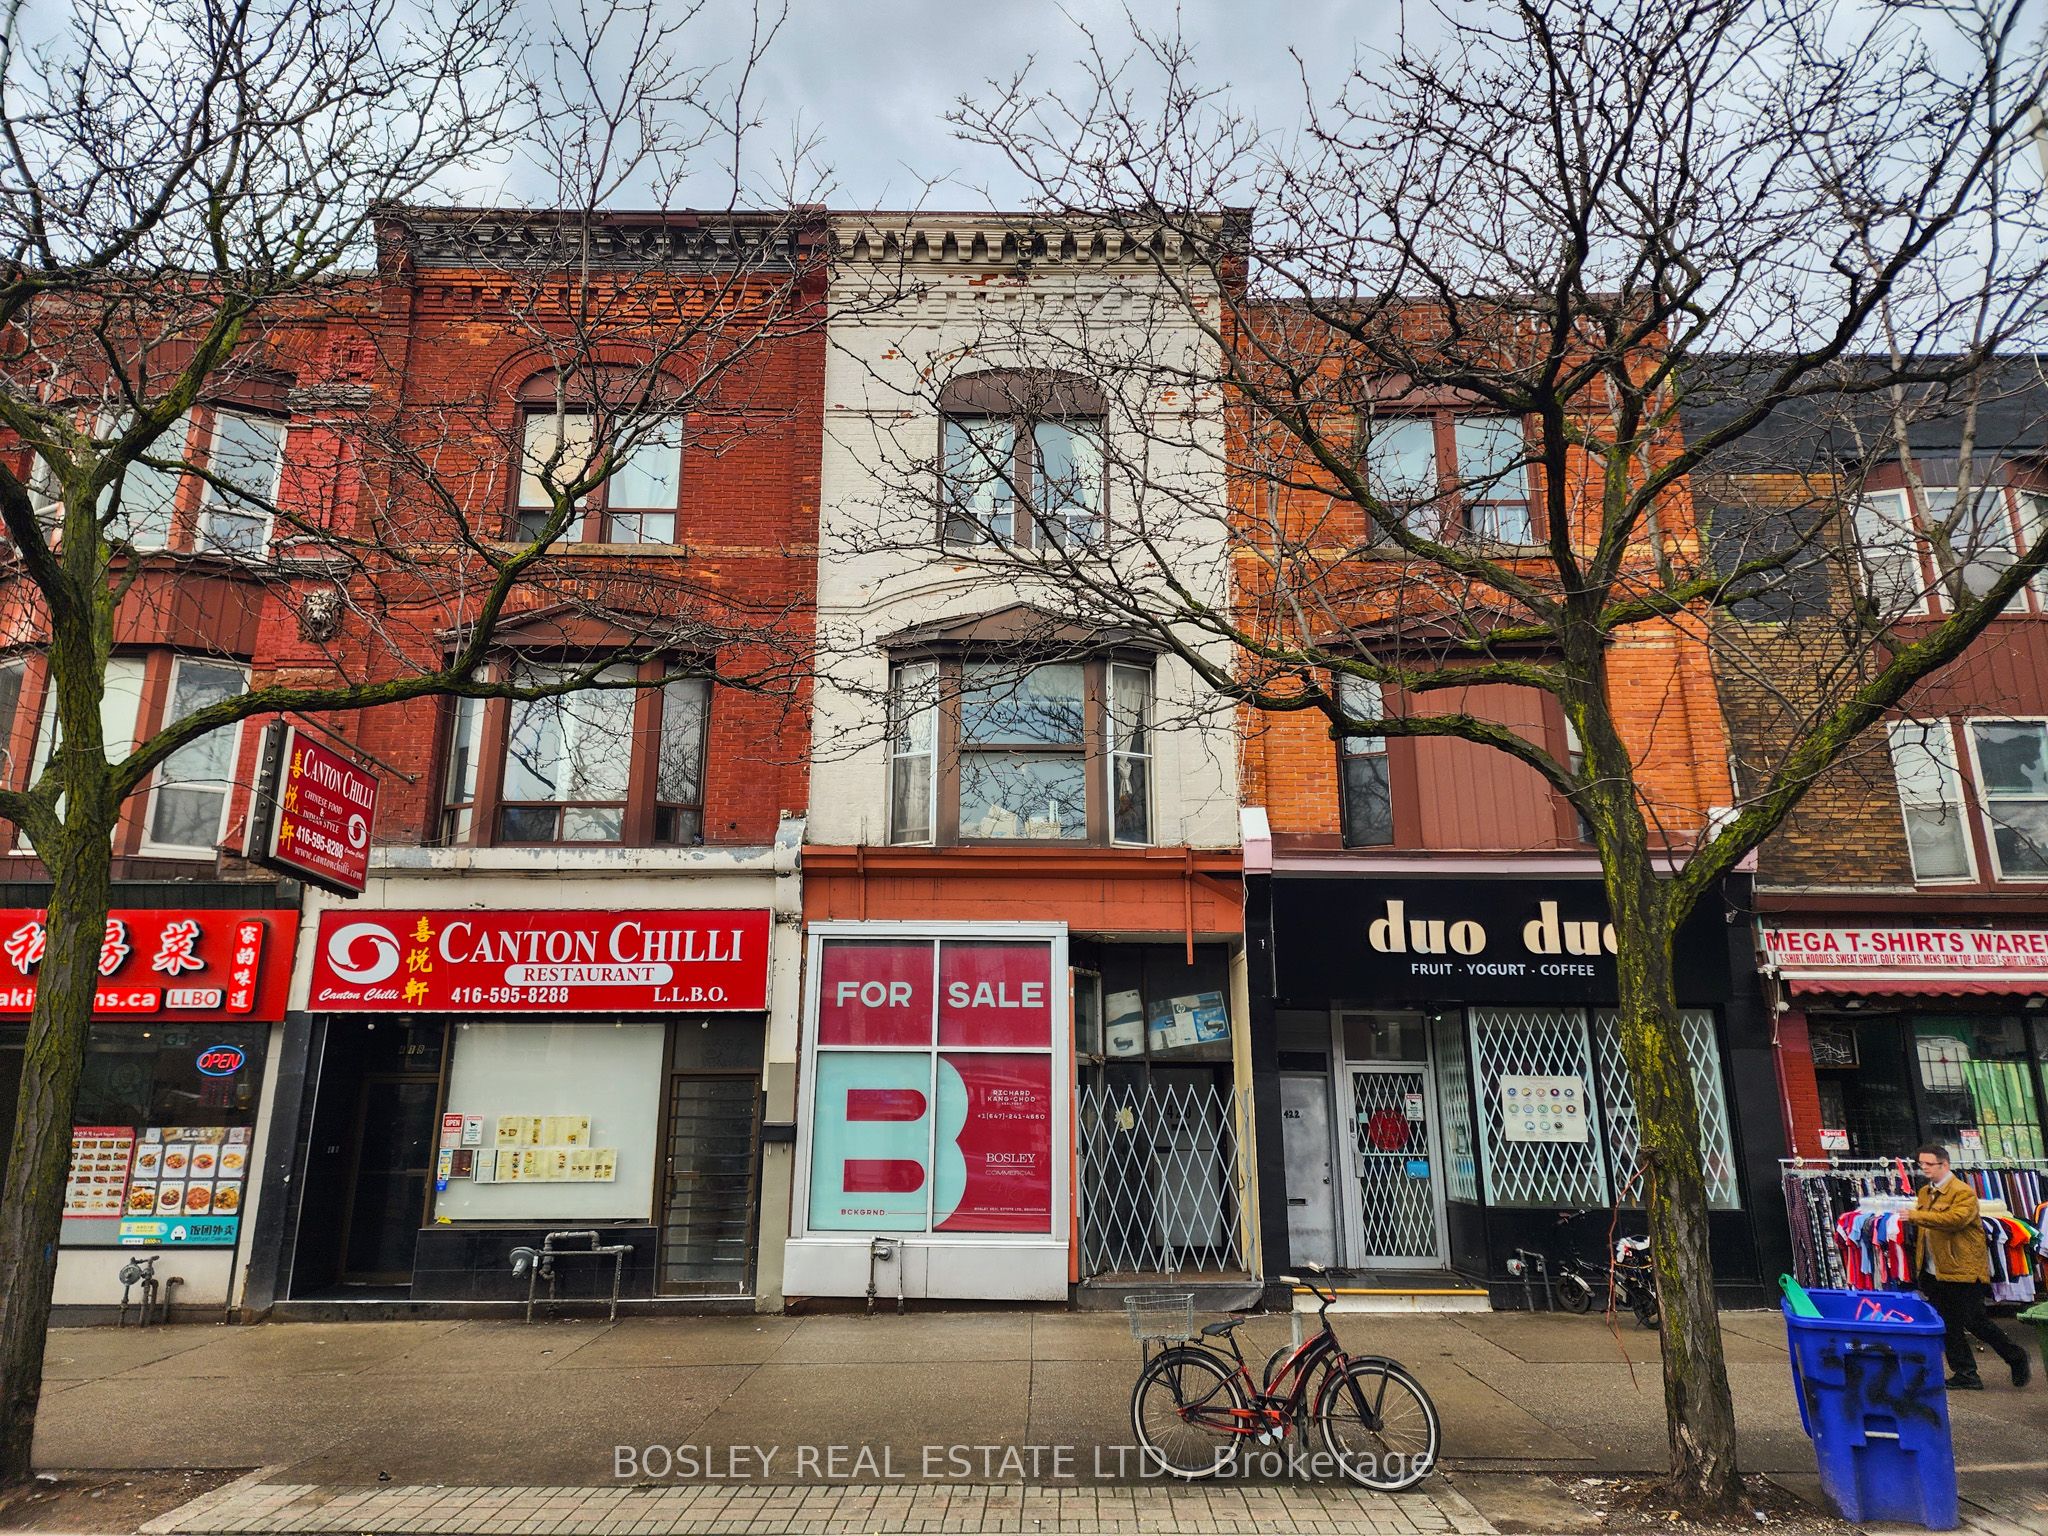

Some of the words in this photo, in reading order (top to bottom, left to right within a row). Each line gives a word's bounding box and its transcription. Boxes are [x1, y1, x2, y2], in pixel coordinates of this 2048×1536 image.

[303, 749, 344, 793] CANTON
[342, 771, 374, 810] CHILLI
[304, 790, 328, 808] CHINESE
[327, 800, 343, 815] FOOD
[322, 820, 340, 834] STYLE
[296, 825, 344, 859] 416-595-8288
[1368, 900, 1487, 955] duo
[438, 921, 600, 964] CANTON
[608, 921, 743, 963] CHILLI
[1765, 932, 1840, 953] MEGA
[1971, 933, 2048, 953] WARE
[230, 925, 260, 1009] 家的味道
[1836, 954, 1857, 964] SWEAT
[1880, 954, 1896, 964] GOLF
[1923, 954, 1942, 965] MENS
[1942, 954, 1959, 965] TANK
[1973, 954, 1996, 965] LADIES
[523, 967, 655, 982] RESTAURANT
[1411, 963, 1453, 976] FRUIT
[1466, 964, 1526, 976] YOGURT
[1540, 964, 1595, 977] COFFEE
[170, 991, 219, 1006] LLBO
[318, 987, 361, 1001] Canton
[363, 986, 399, 1001] Chilli
[451, 987, 569, 1004] 416-595-8288
[653, 986, 729, 1002] L.L.B.O.
[836, 981, 913, 1008] FOR
[947, 981, 1044, 1008] SALE
[199, 1053, 241, 1069] OPEN
[1283, 1110, 1300, 1119] 422
[445, 1119, 460, 1127] OPEN
[986, 1153, 1036, 1163] BOSLEY
